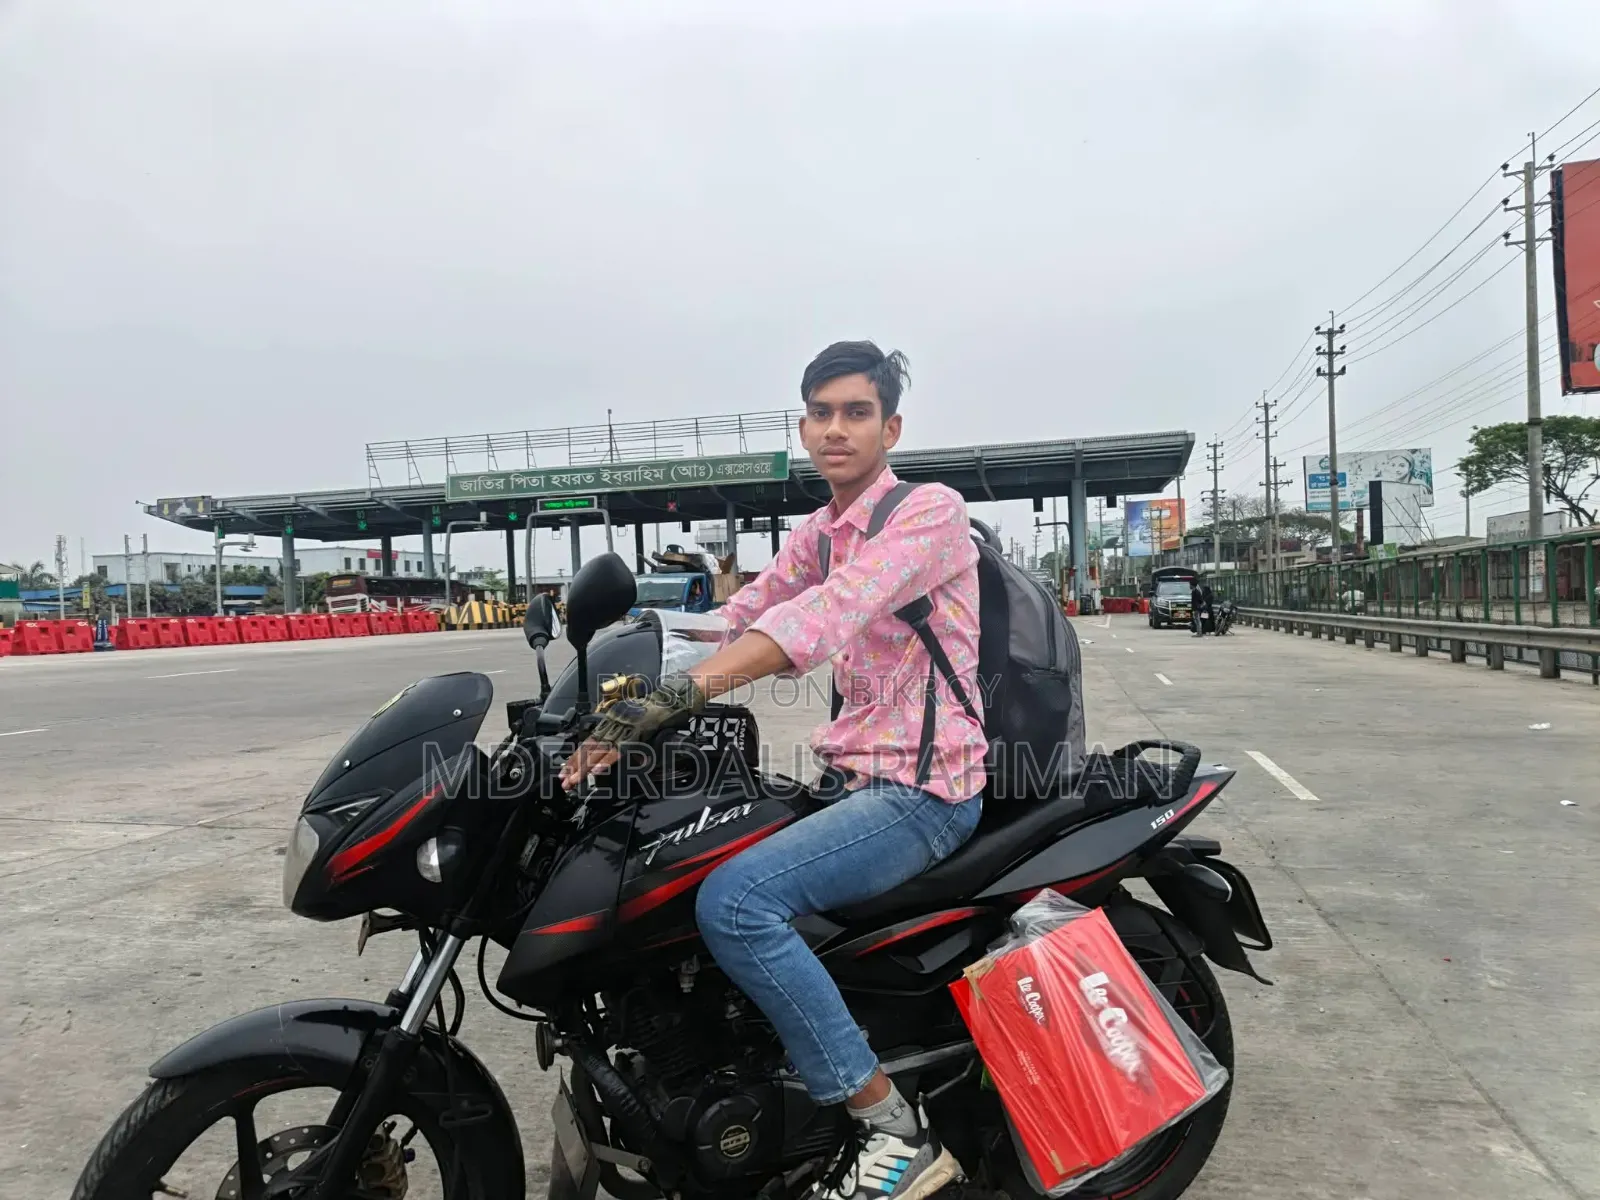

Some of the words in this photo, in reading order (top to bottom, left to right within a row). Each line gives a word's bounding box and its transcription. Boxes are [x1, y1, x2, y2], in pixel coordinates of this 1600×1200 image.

[459, 475, 506, 493] জাতির
[509, 472, 546, 490] পিতা
[550, 471, 598, 488] হযরত
[1150, 808, 1175, 830] 150
[1017, 976, 1033, 996] Lee
